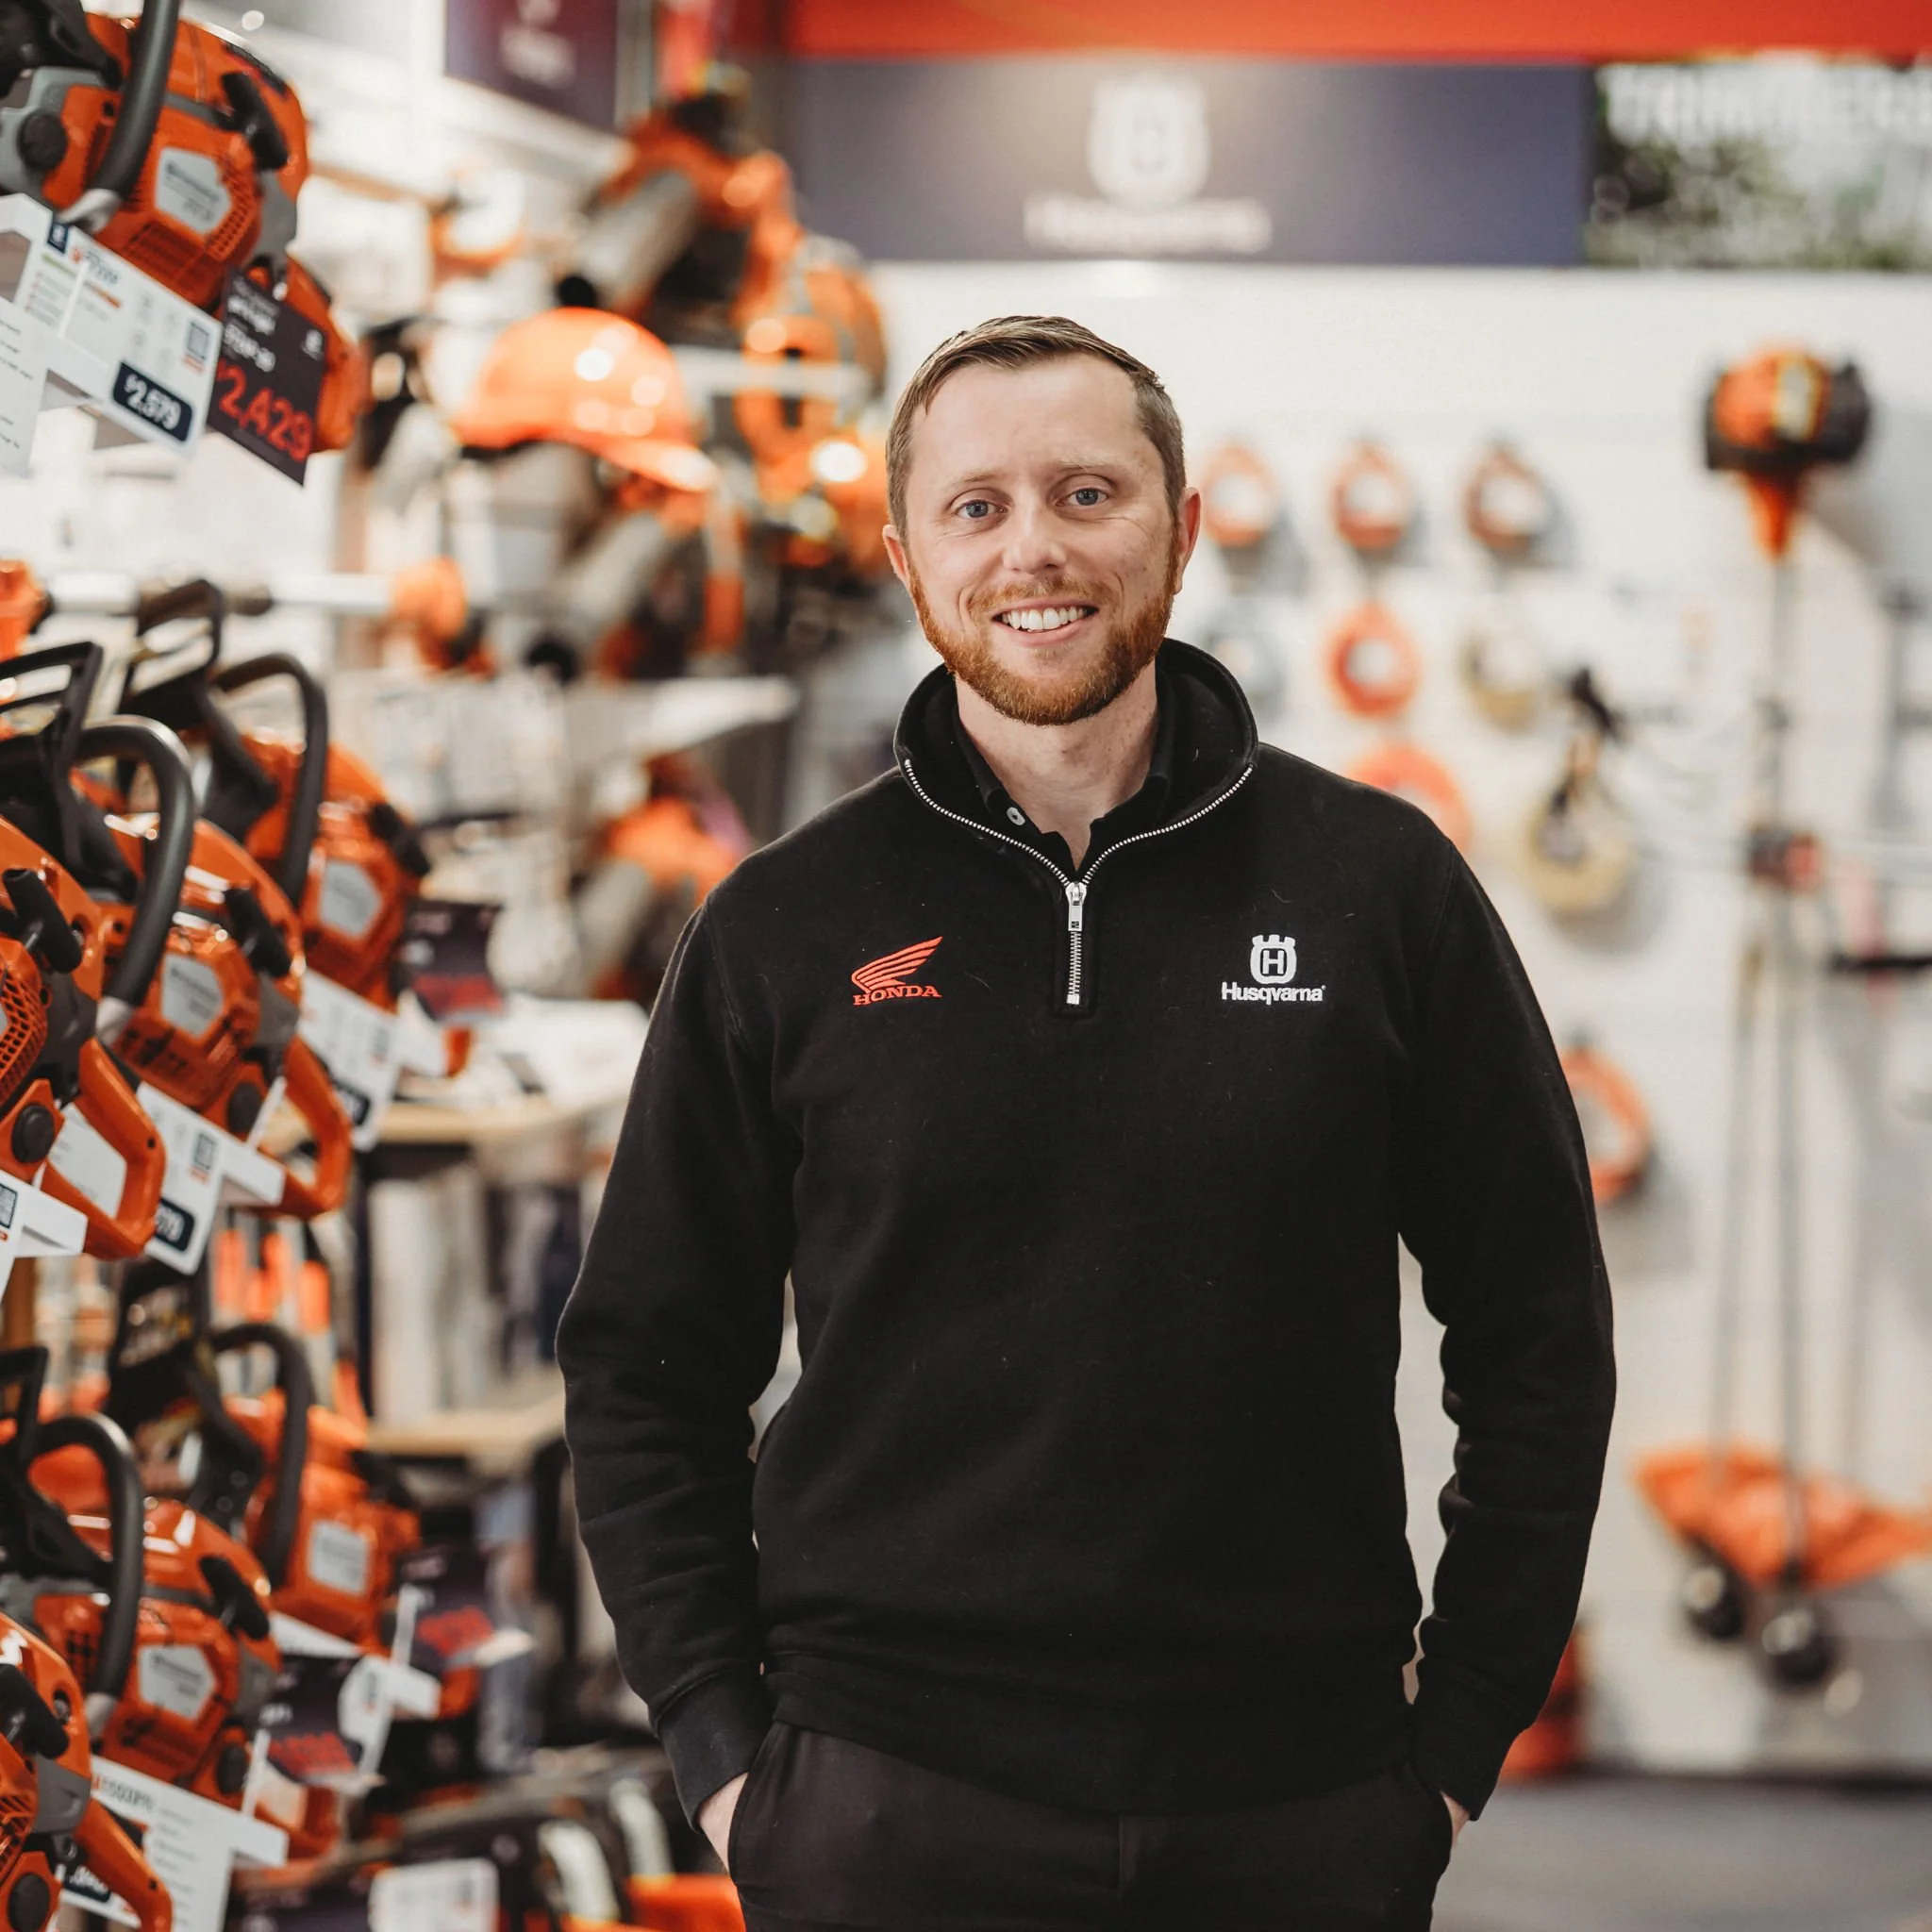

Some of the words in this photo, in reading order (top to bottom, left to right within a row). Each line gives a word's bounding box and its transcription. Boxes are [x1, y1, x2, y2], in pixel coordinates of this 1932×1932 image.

[1262, 950, 1285, 974] H
[853, 985, 942, 1006] HONDA
[1221, 981, 1324, 1006] Husqvarna
